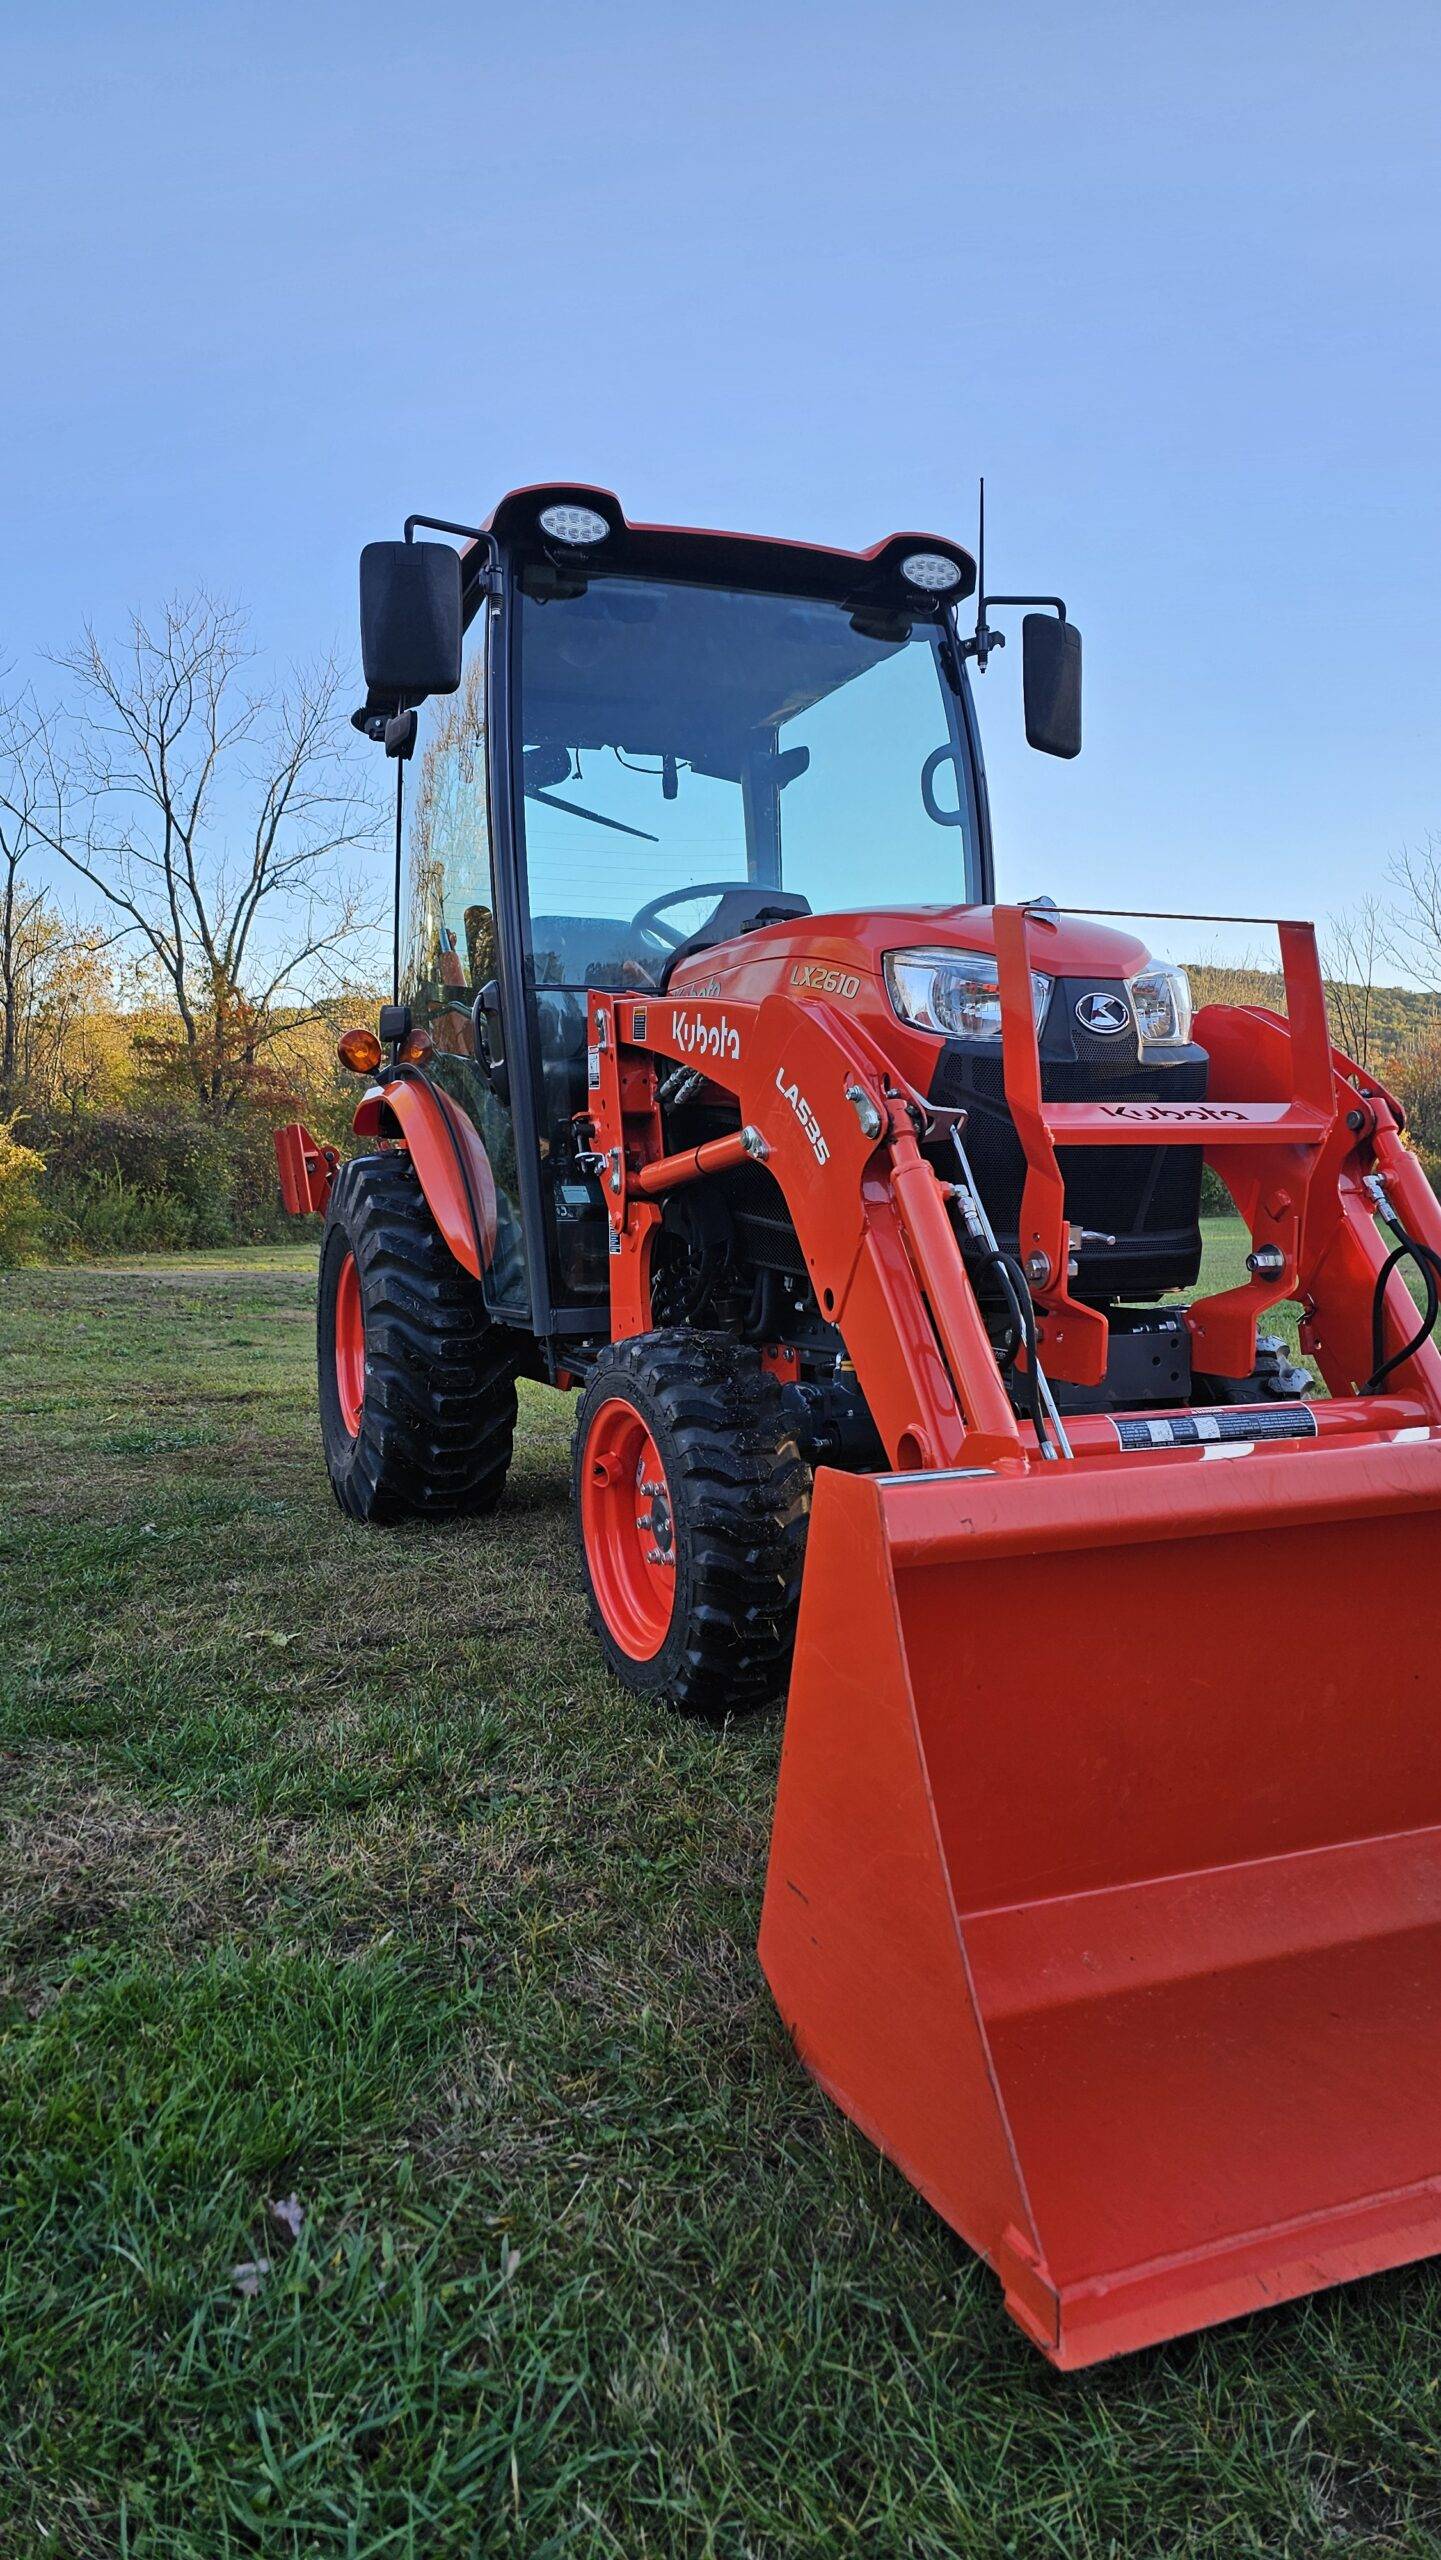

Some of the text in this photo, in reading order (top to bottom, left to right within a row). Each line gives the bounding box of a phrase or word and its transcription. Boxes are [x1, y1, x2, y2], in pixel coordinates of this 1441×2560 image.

[790, 964, 861, 999] LX2610
[672, 1010, 740, 1060] Kubota
[775, 1066, 831, 1166] LA535
[1098, 1106, 1250, 1121] Kubota
